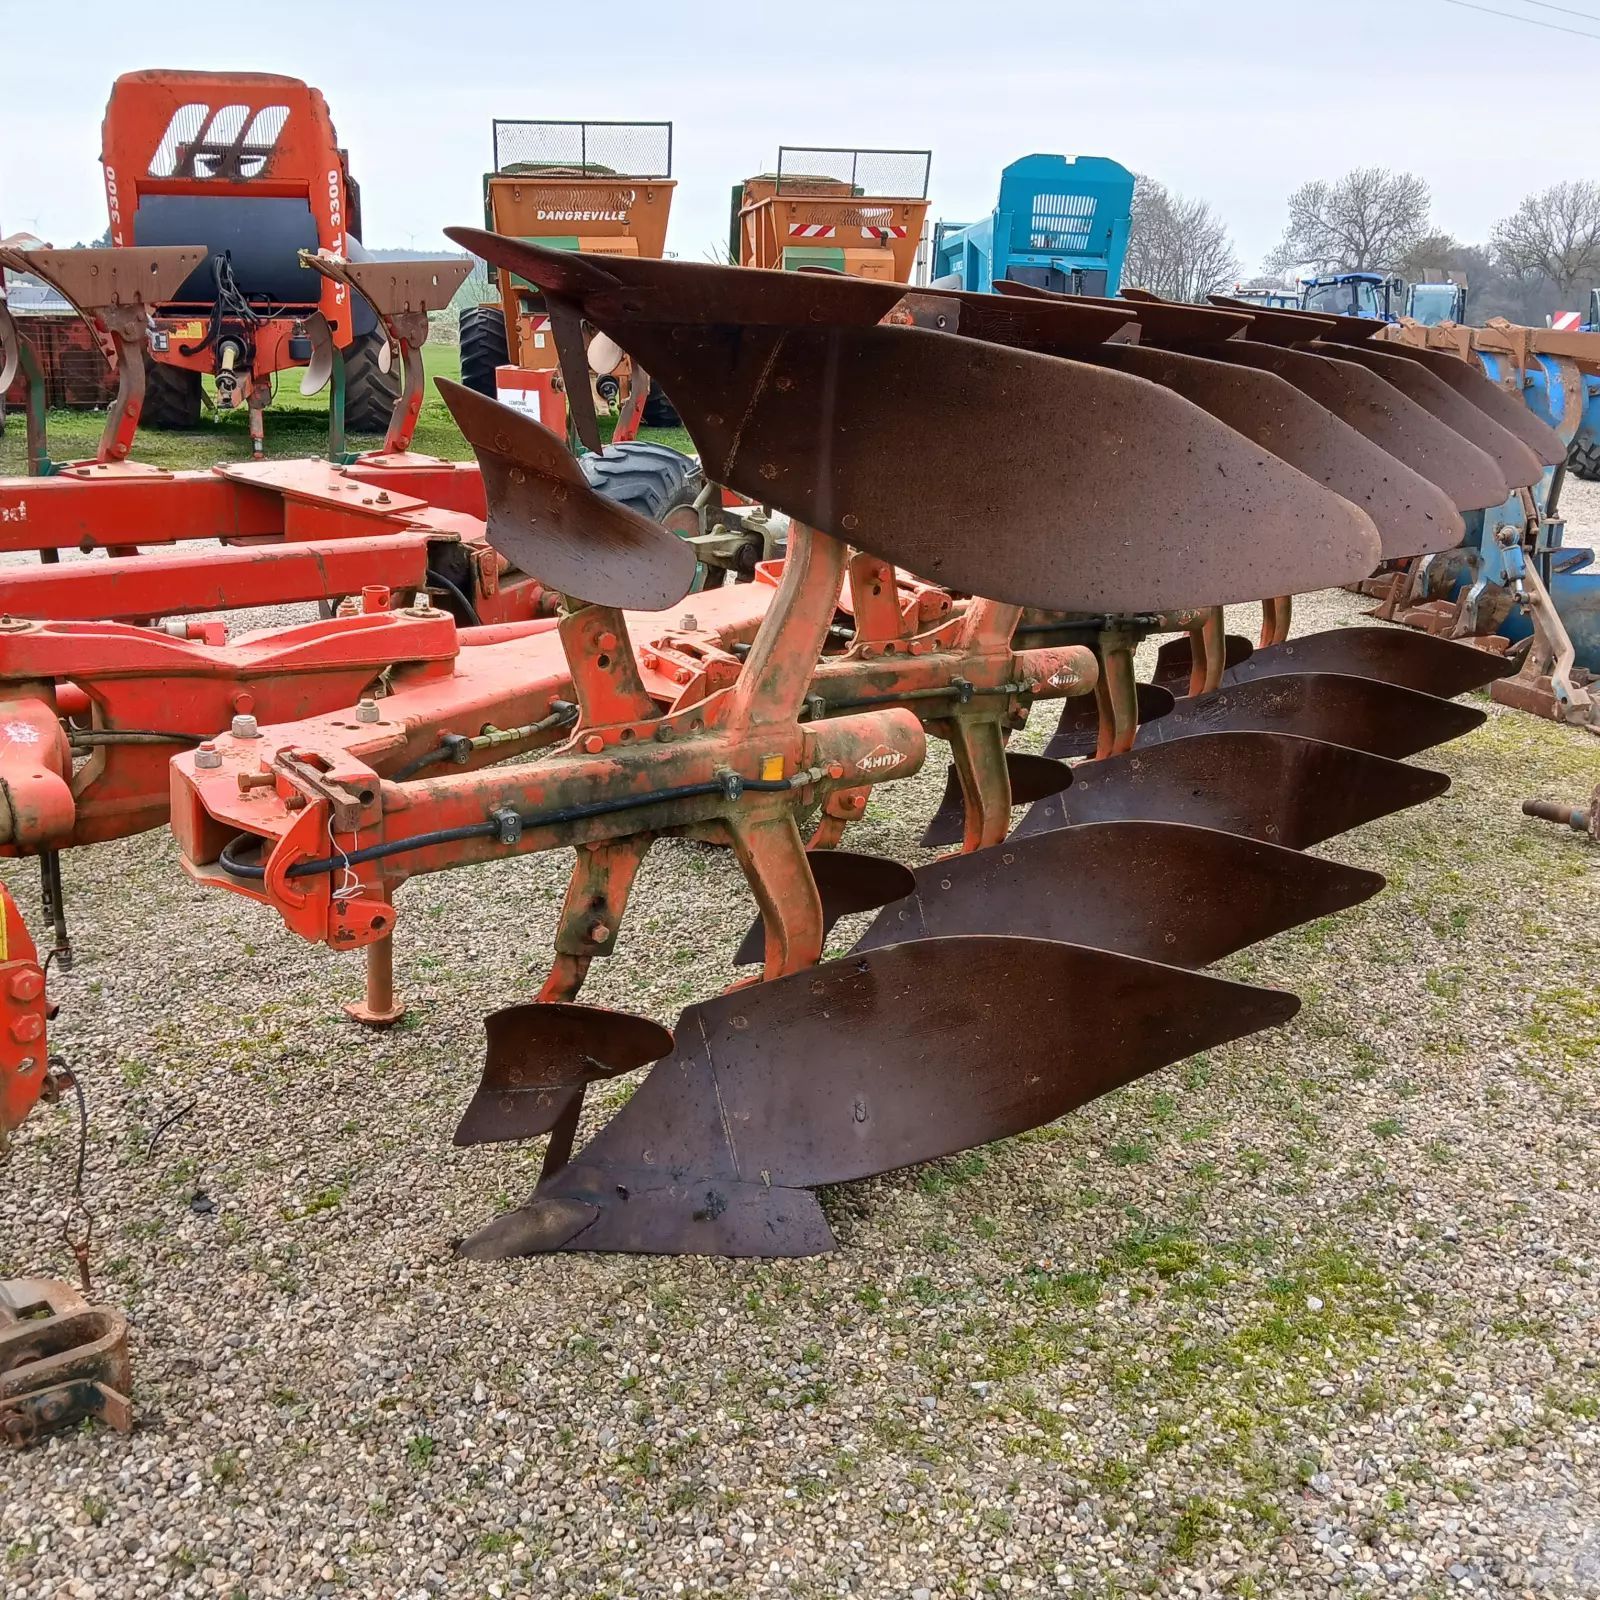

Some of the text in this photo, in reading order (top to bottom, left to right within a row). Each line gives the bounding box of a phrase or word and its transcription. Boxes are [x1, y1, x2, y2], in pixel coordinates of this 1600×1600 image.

[106, 166, 120, 224] 3300
[328, 170, 341, 227] 3300
[537, 210, 626, 221] DANGREVILLE
[863, 753, 901, 769] KUHN
